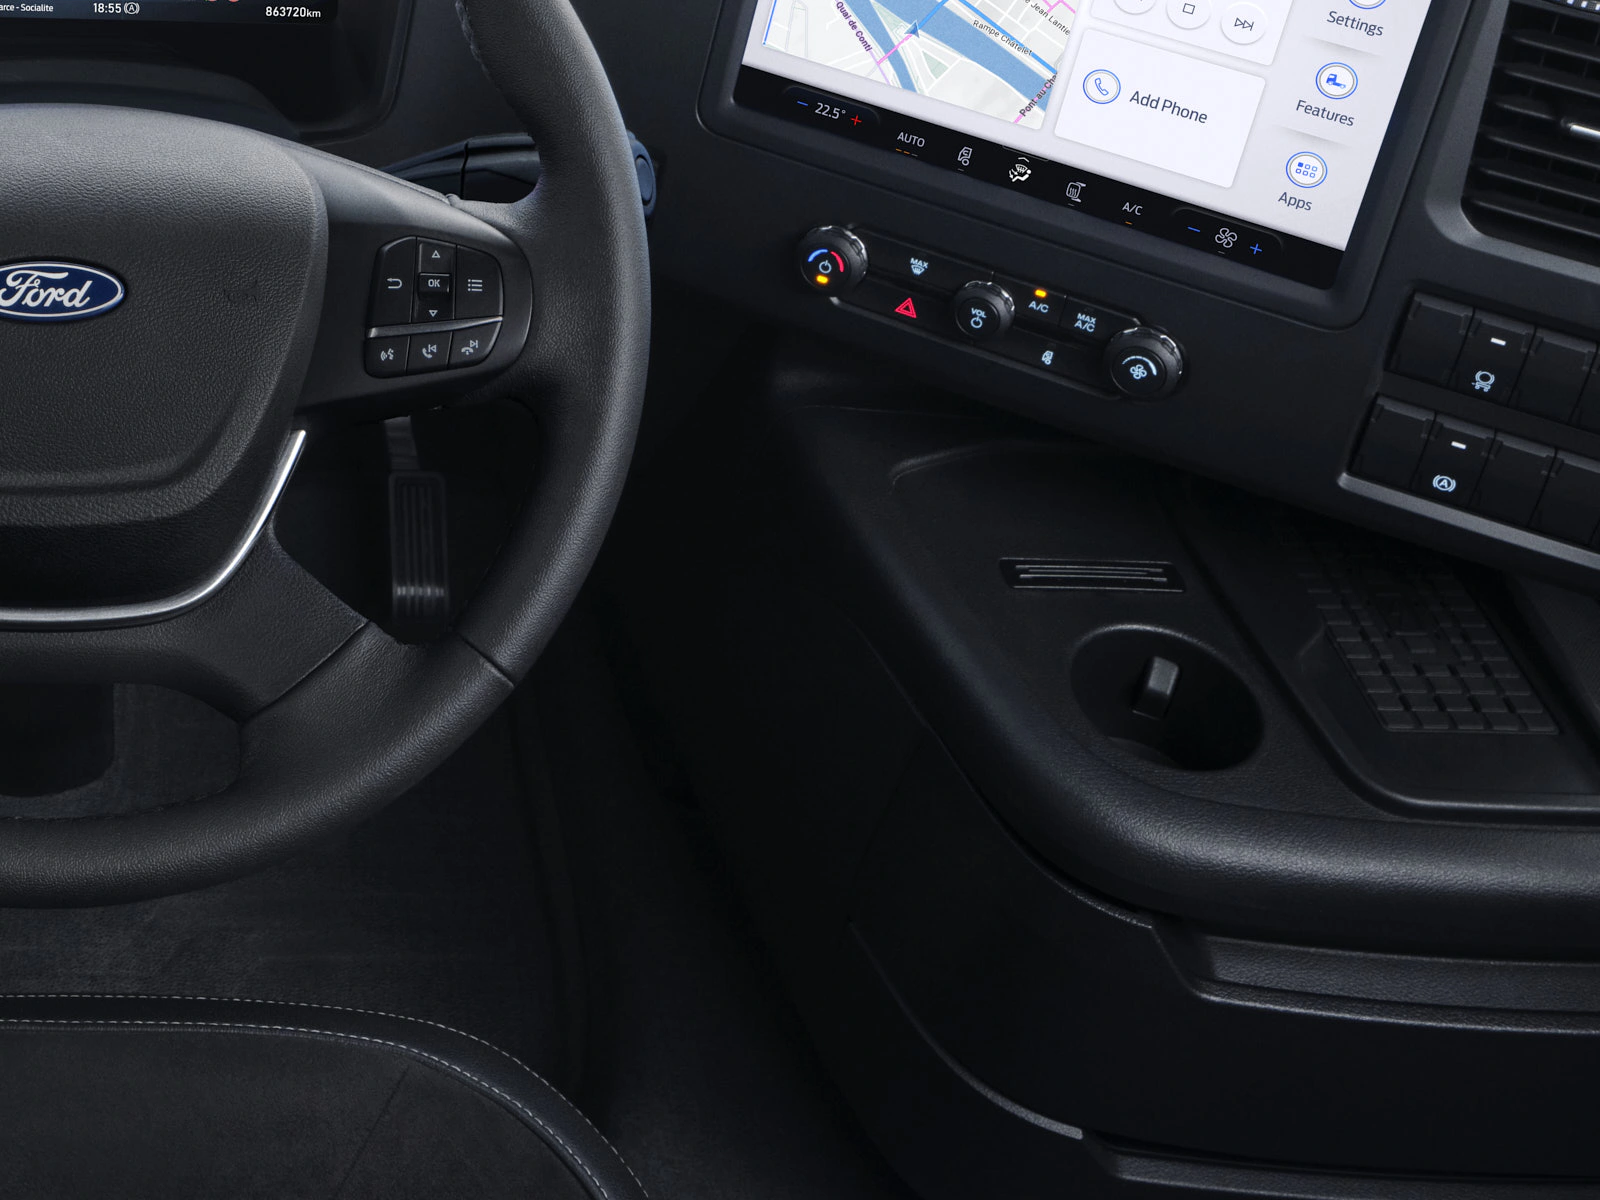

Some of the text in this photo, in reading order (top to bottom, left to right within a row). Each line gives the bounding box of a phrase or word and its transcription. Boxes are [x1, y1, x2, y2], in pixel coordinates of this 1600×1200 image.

[21, 3, 54, 13] Socialite
[93, 3, 122, 14] 18:55
[1031, 2, 1049, 18] Jean
[836, 1, 873, 52] Quai de Conti
[973, 19, 1000, 38] Rampe
[1326, 10, 1384, 38] Settings
[1019, 99, 1037, 117] Pont
[1036, 89, 1046, 100] au
[1129, 89, 1208, 124] Add Phone
[1296, 99, 1355, 127] Features
[897, 131, 925, 148] AUTO
[1122, 201, 1143, 216] A/C
[1278, 191, 1313, 212] Apps
[910, 257, 929, 269] MAX
[428, 279, 441, 288] OK
[971, 307, 987, 319] VOL
[1029, 300, 1049, 313] A/C
[1077, 312, 1097, 325] MAX
[1074, 320, 1096, 333] A/C
